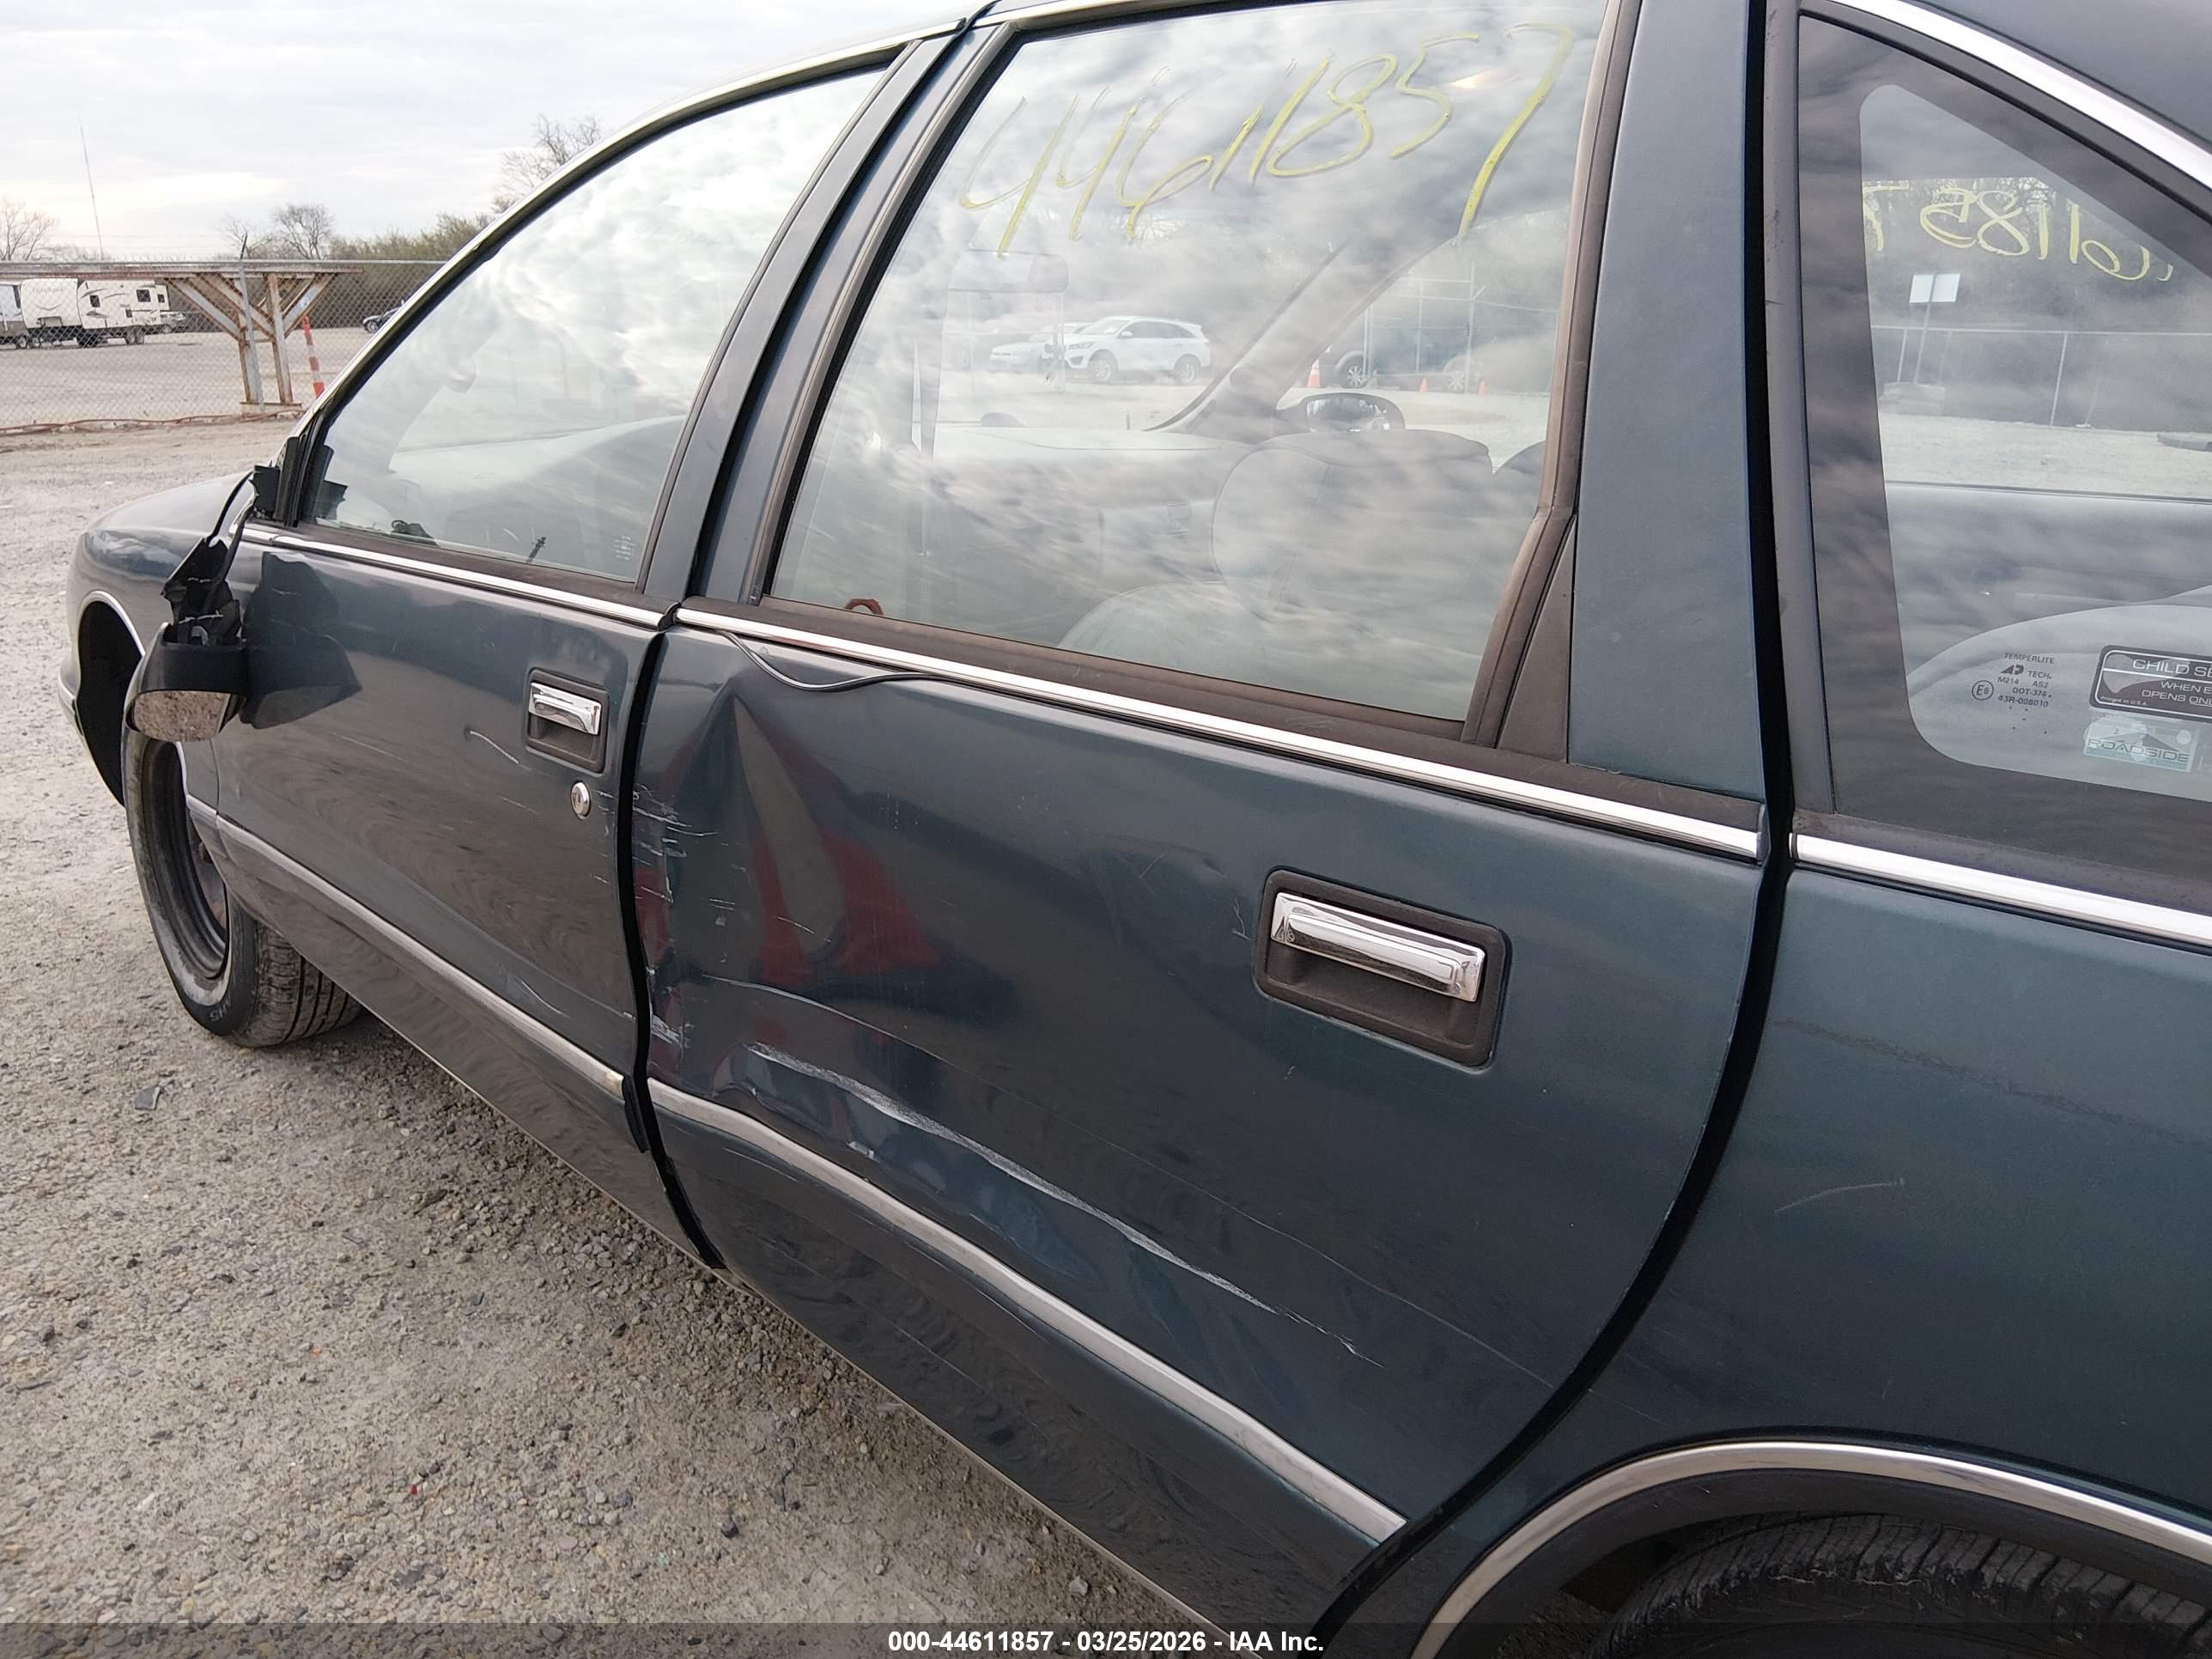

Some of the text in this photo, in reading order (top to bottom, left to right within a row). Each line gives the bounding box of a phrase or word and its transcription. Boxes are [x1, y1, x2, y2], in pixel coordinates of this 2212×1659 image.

[960, 22, 1575, 259] 44611857
[2003, 653, 2055, 664] TEMPERLITE
[2132, 659, 2189, 675] CHILD
[1997, 677, 2049, 689] M214 AS2
[2160, 680, 2202, 693] WHEN
[2142, 690, 2186, 702] OPENS
[2087, 738, 2190, 763] ROADSIDE
